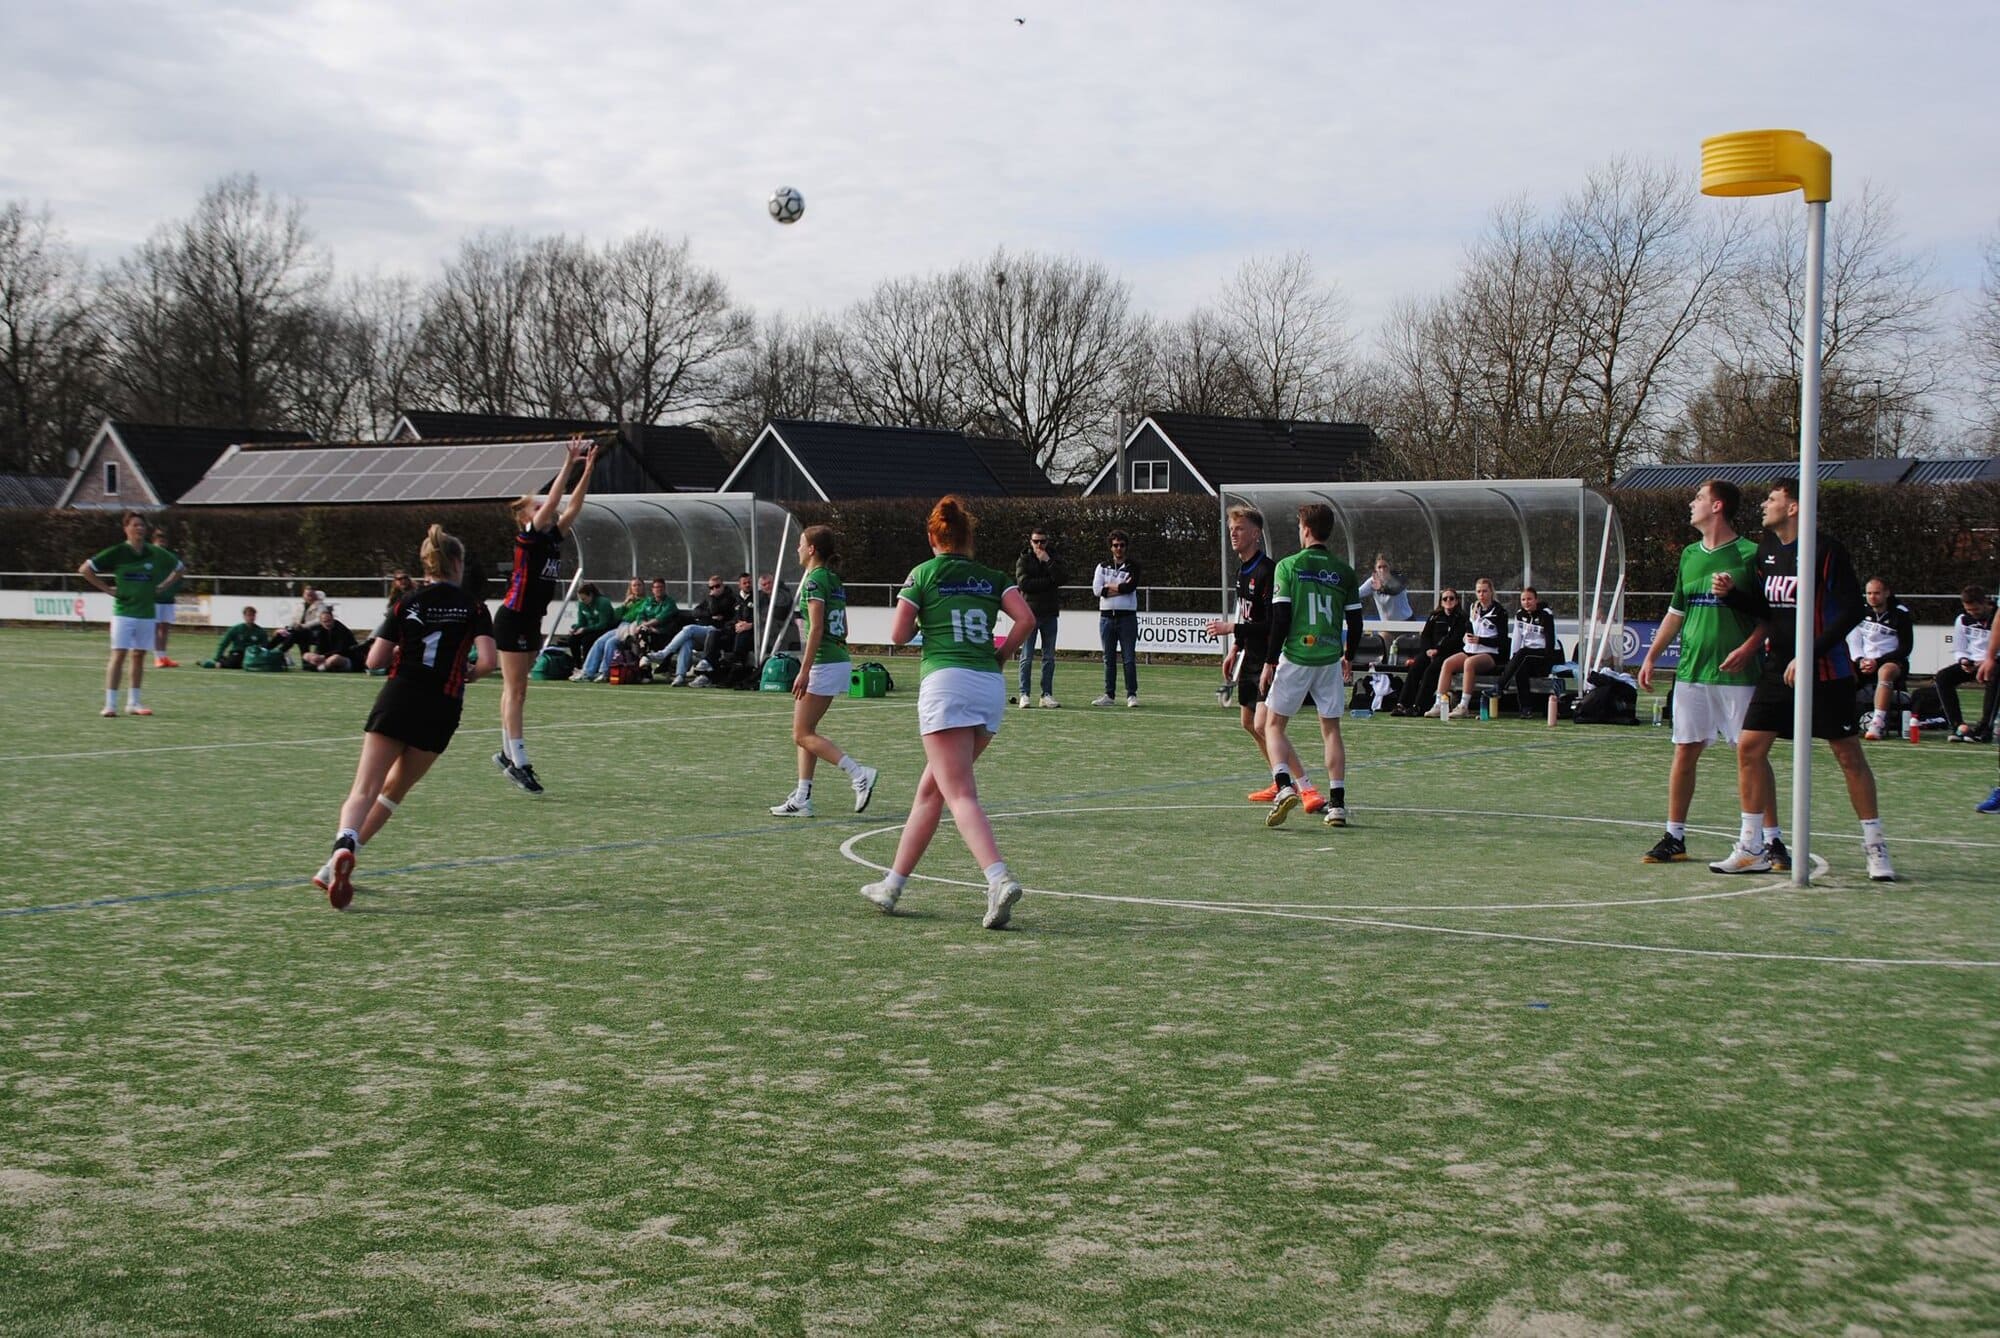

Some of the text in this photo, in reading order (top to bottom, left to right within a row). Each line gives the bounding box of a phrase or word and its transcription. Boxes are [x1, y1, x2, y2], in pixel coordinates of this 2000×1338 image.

[1765, 576, 1797, 602] HHZ
[1136, 616, 1220, 626] CHILDERSBEDR
[1308, 592, 1332, 625] 14
[951, 609, 989, 643] 18
[422, 631, 442, 668] 1
